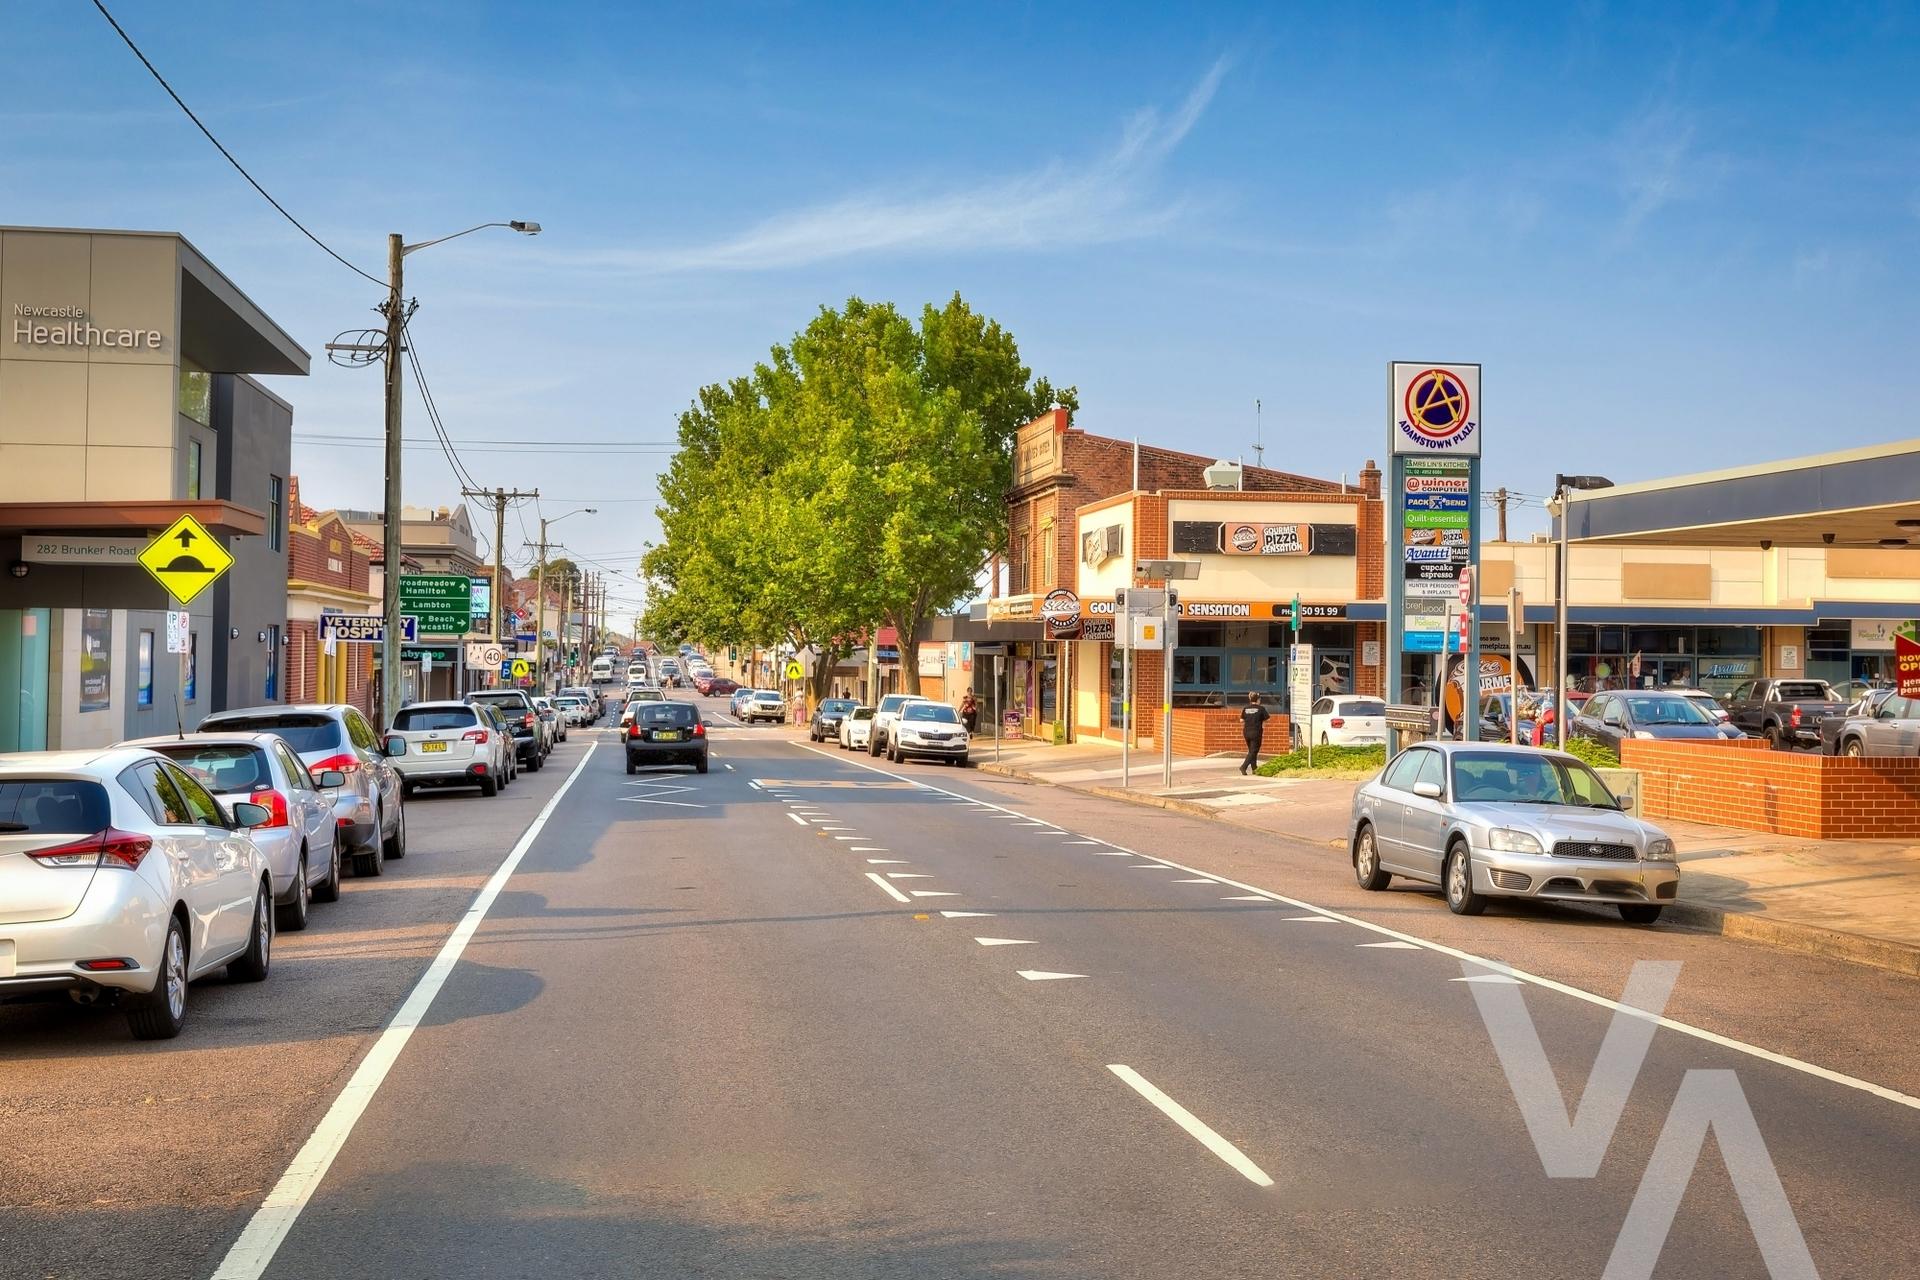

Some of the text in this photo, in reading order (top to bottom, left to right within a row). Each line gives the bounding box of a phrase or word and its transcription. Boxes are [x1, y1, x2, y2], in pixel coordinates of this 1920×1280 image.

[14, 303, 84, 319] Newcastle
[13, 319, 162, 348] Healthcare
[1398, 420, 1476, 449] ADAMSTOWN PLAZA
[1421, 478, 1468, 487] winner
[1263, 526, 1298, 535] GOURMET
[1265, 533, 1298, 545] PIZZA
[37, 544, 137, 556] 282 Brunker Road
[1262, 543, 1303, 554] SENSATION
[1451, 547, 1469, 555] HAIR
[1420, 564, 1454, 572] cupcake
[1188, 603, 1250, 616] SENSATION
[1314, 607, 1325, 615] 91
[1327, 607, 1338, 615] 99
[168, 613, 178, 624] 1P
[326, 616, 411, 628] VETERINY
[324, 626, 411, 640] OSPIL
[1085, 624, 1112, 634] PIZZA
[486, 652, 500, 661] 40
[1900, 662, 1920, 671] OP
[502, 668, 510, 678] P
